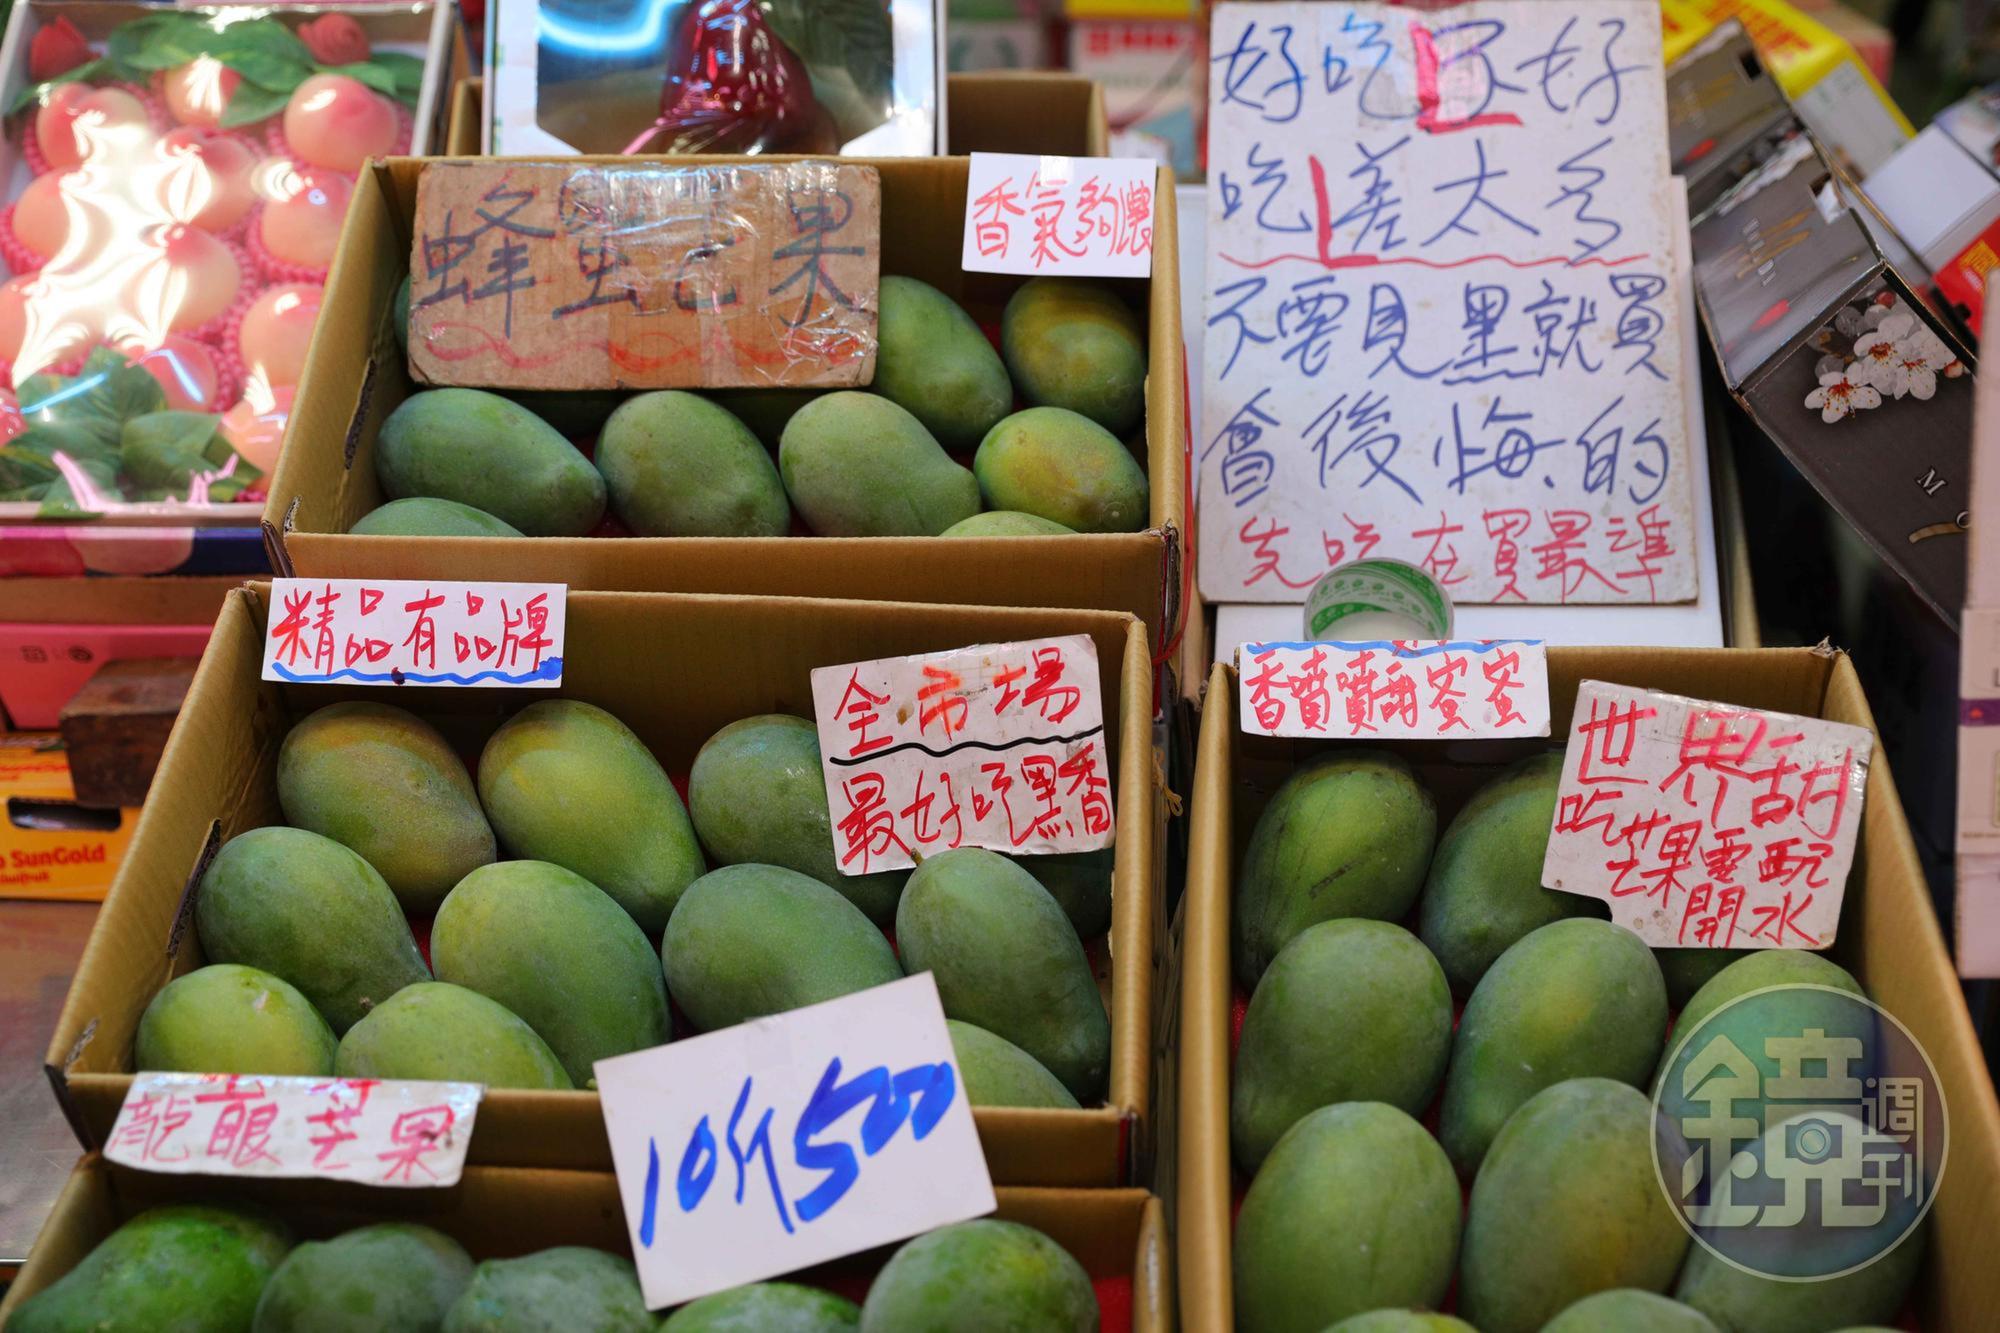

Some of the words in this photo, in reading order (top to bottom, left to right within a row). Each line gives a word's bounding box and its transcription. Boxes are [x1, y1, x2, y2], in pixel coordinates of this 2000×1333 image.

[271, 583, 554, 676] 精品有品牌
[834, 647, 1081, 757] 全市場
[10, 843, 106, 868] SunGold
[1678, 883, 1820, 948] 開水
